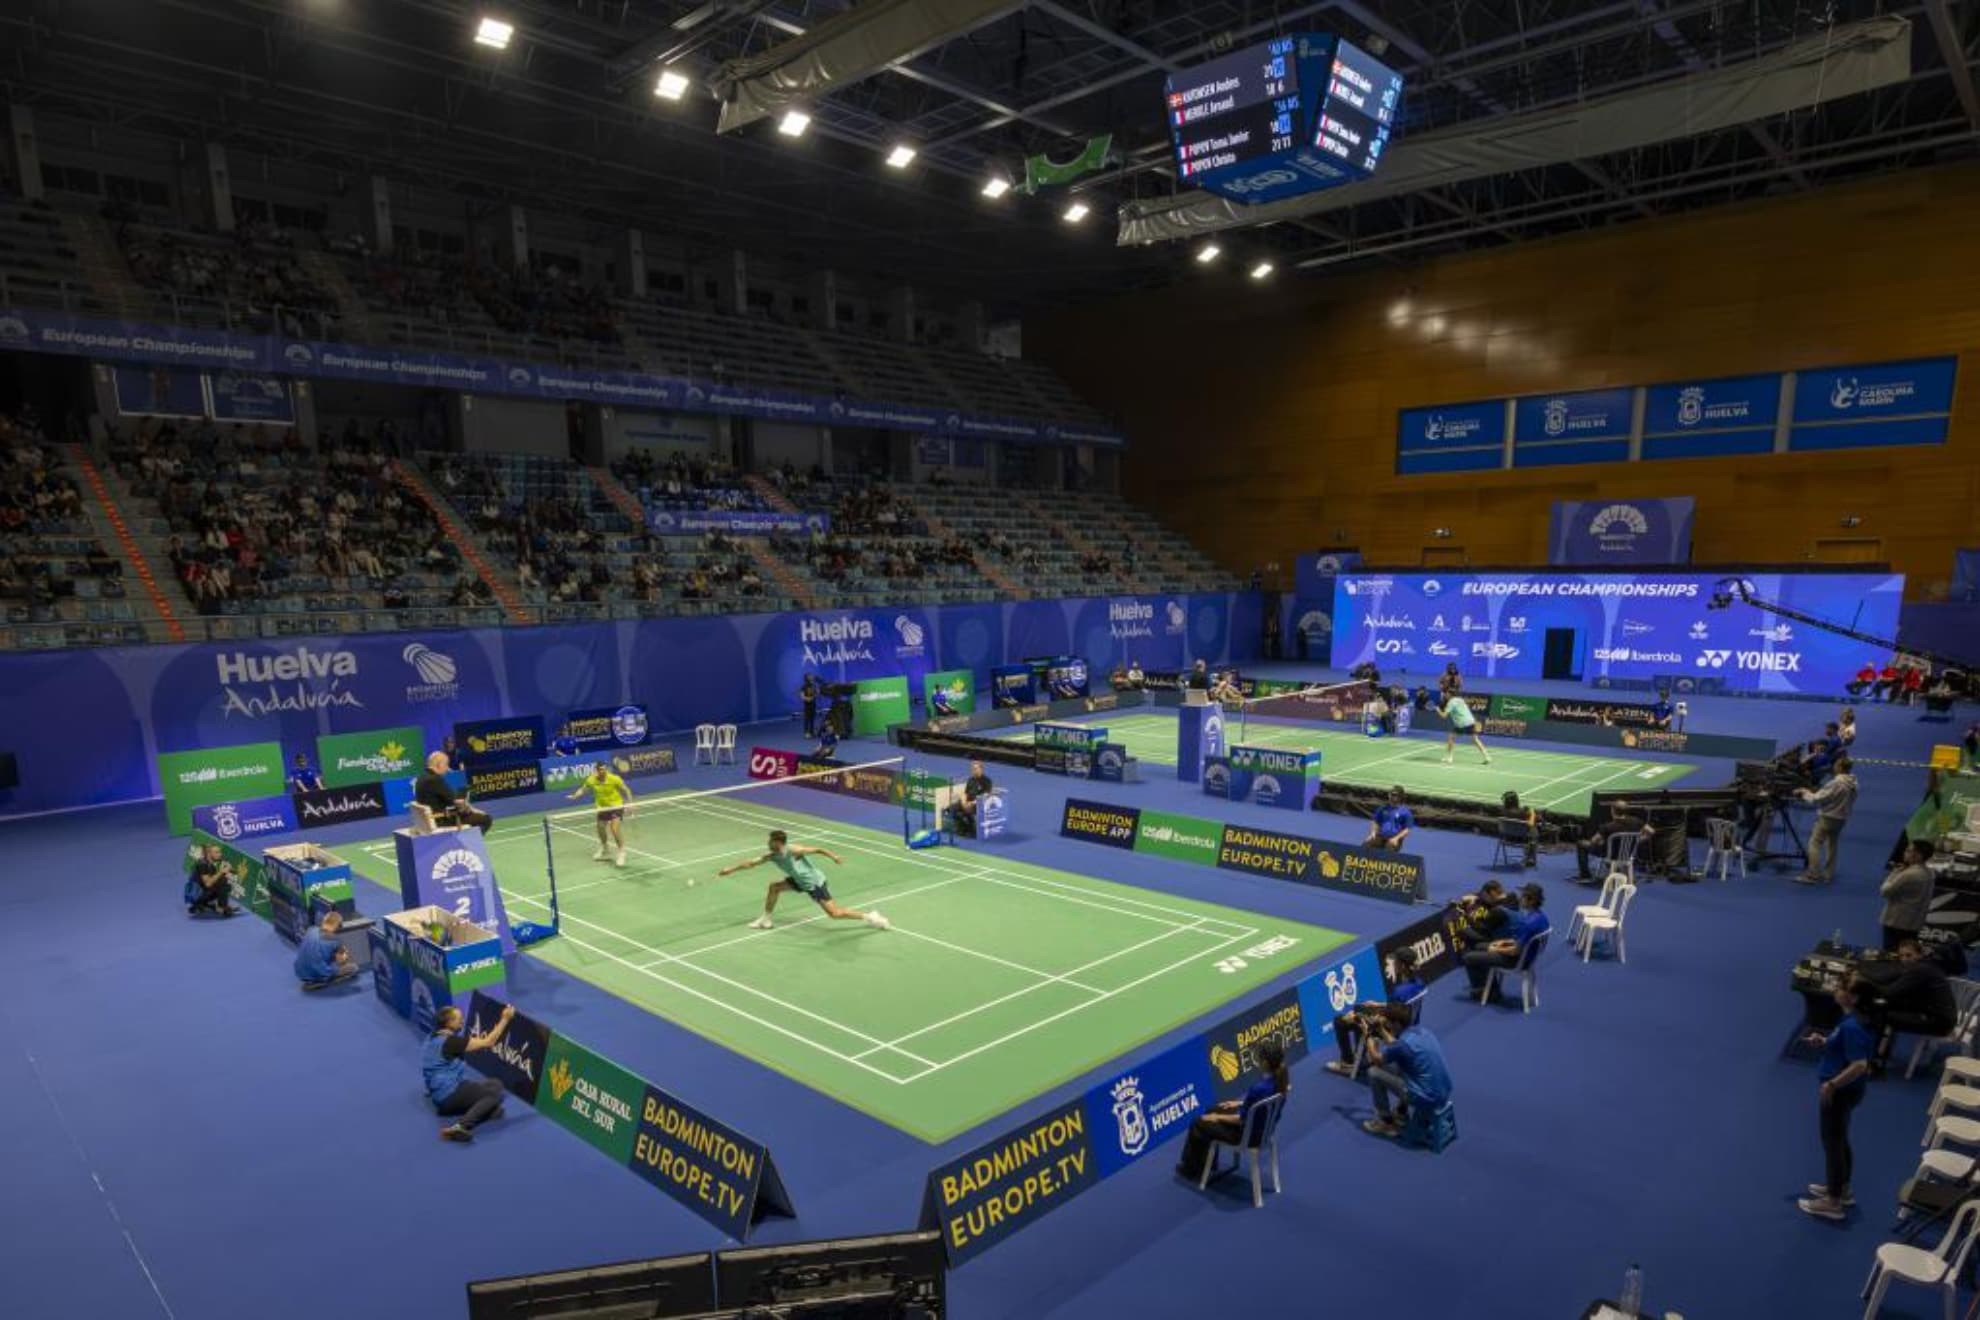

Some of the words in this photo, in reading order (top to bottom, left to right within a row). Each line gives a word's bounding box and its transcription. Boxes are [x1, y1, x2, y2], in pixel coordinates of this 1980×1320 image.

[42, 328, 128, 348] European
[133, 336, 256, 360] Championships
[1704, 407, 1748, 418] HUELVA
[1462, 582, 1556, 595] EUROPEAN
[1558, 582, 1699, 596] CHAMPIONSHIPS
[1109, 600, 1154, 621] Huelva
[800, 616, 873, 642] Huelva
[216, 646, 358, 686] Huelva
[802, 640, 876, 666] Andalucía
[1736, 650, 1802, 672] YONEX
[218, 679, 368, 720] Andalucía
[571, 764, 598, 779] YON
[1258, 752, 1302, 772] YONEX
[472, 768, 537, 785] BADMINTON
[303, 793, 382, 819] Andalucía
[1068, 806, 1134, 829] BADMINTON
[244, 818, 285, 832] HUELVA
[1066, 818, 1108, 836] EUROPE
[1108, 826, 1132, 840] APP
[1225, 829, 1312, 857] BADMINTON
[1221, 848, 1306, 877] EUROPE.TV
[1344, 854, 1418, 878] BADMINTON
[1341, 865, 1414, 894] EUROPE
[454, 896, 471, 918] 2
[408, 938, 444, 979] YONEX
[1236, 1001, 1300, 1049] BADMINTON
[470, 1012, 534, 1082] Analucía
[1240, 1019, 1304, 1073] EUOPE
[574, 1078, 598, 1103] CAJA
[598, 1091, 632, 1122] RURAL
[1152, 1093, 1200, 1132] HUELVA
[571, 1096, 591, 1118] DEL
[593, 1109, 616, 1134] SUR
[642, 1096, 756, 1180] BADMINTON
[942, 1109, 1084, 1207] BADMINTON
[635, 1133, 745, 1218] EUROPE.TV
[950, 1147, 1086, 1249] EUROPE.TV
